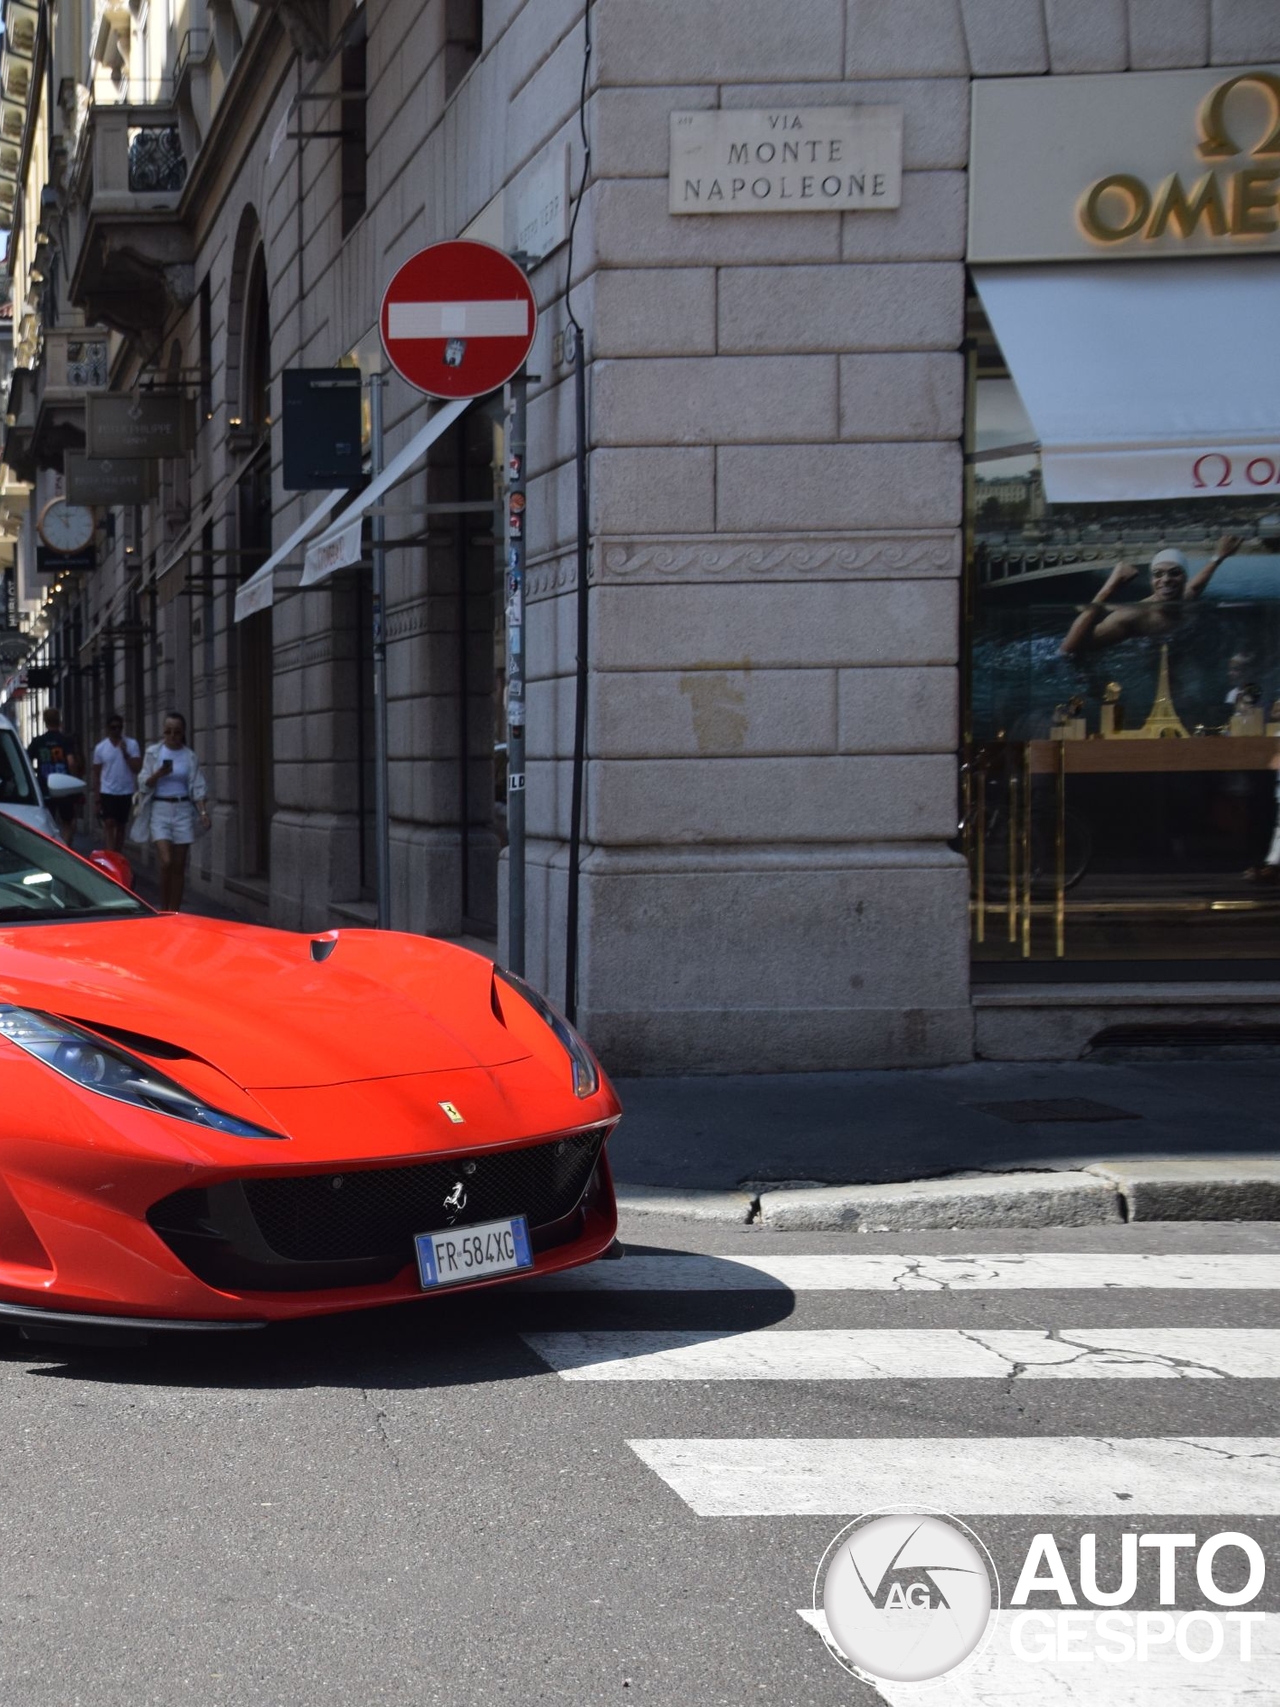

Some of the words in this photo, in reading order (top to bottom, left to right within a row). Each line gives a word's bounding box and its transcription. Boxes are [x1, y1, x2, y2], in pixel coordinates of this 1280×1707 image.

[769, 115, 803, 130] VIA
[727, 140, 843, 165] MONTE
[684, 173, 886, 201] NAPOLEONE
[1078, 171, 1280, 241] OME
[1246, 457, 1280, 486] O
[7, 581, 18, 627] HUBLOT
